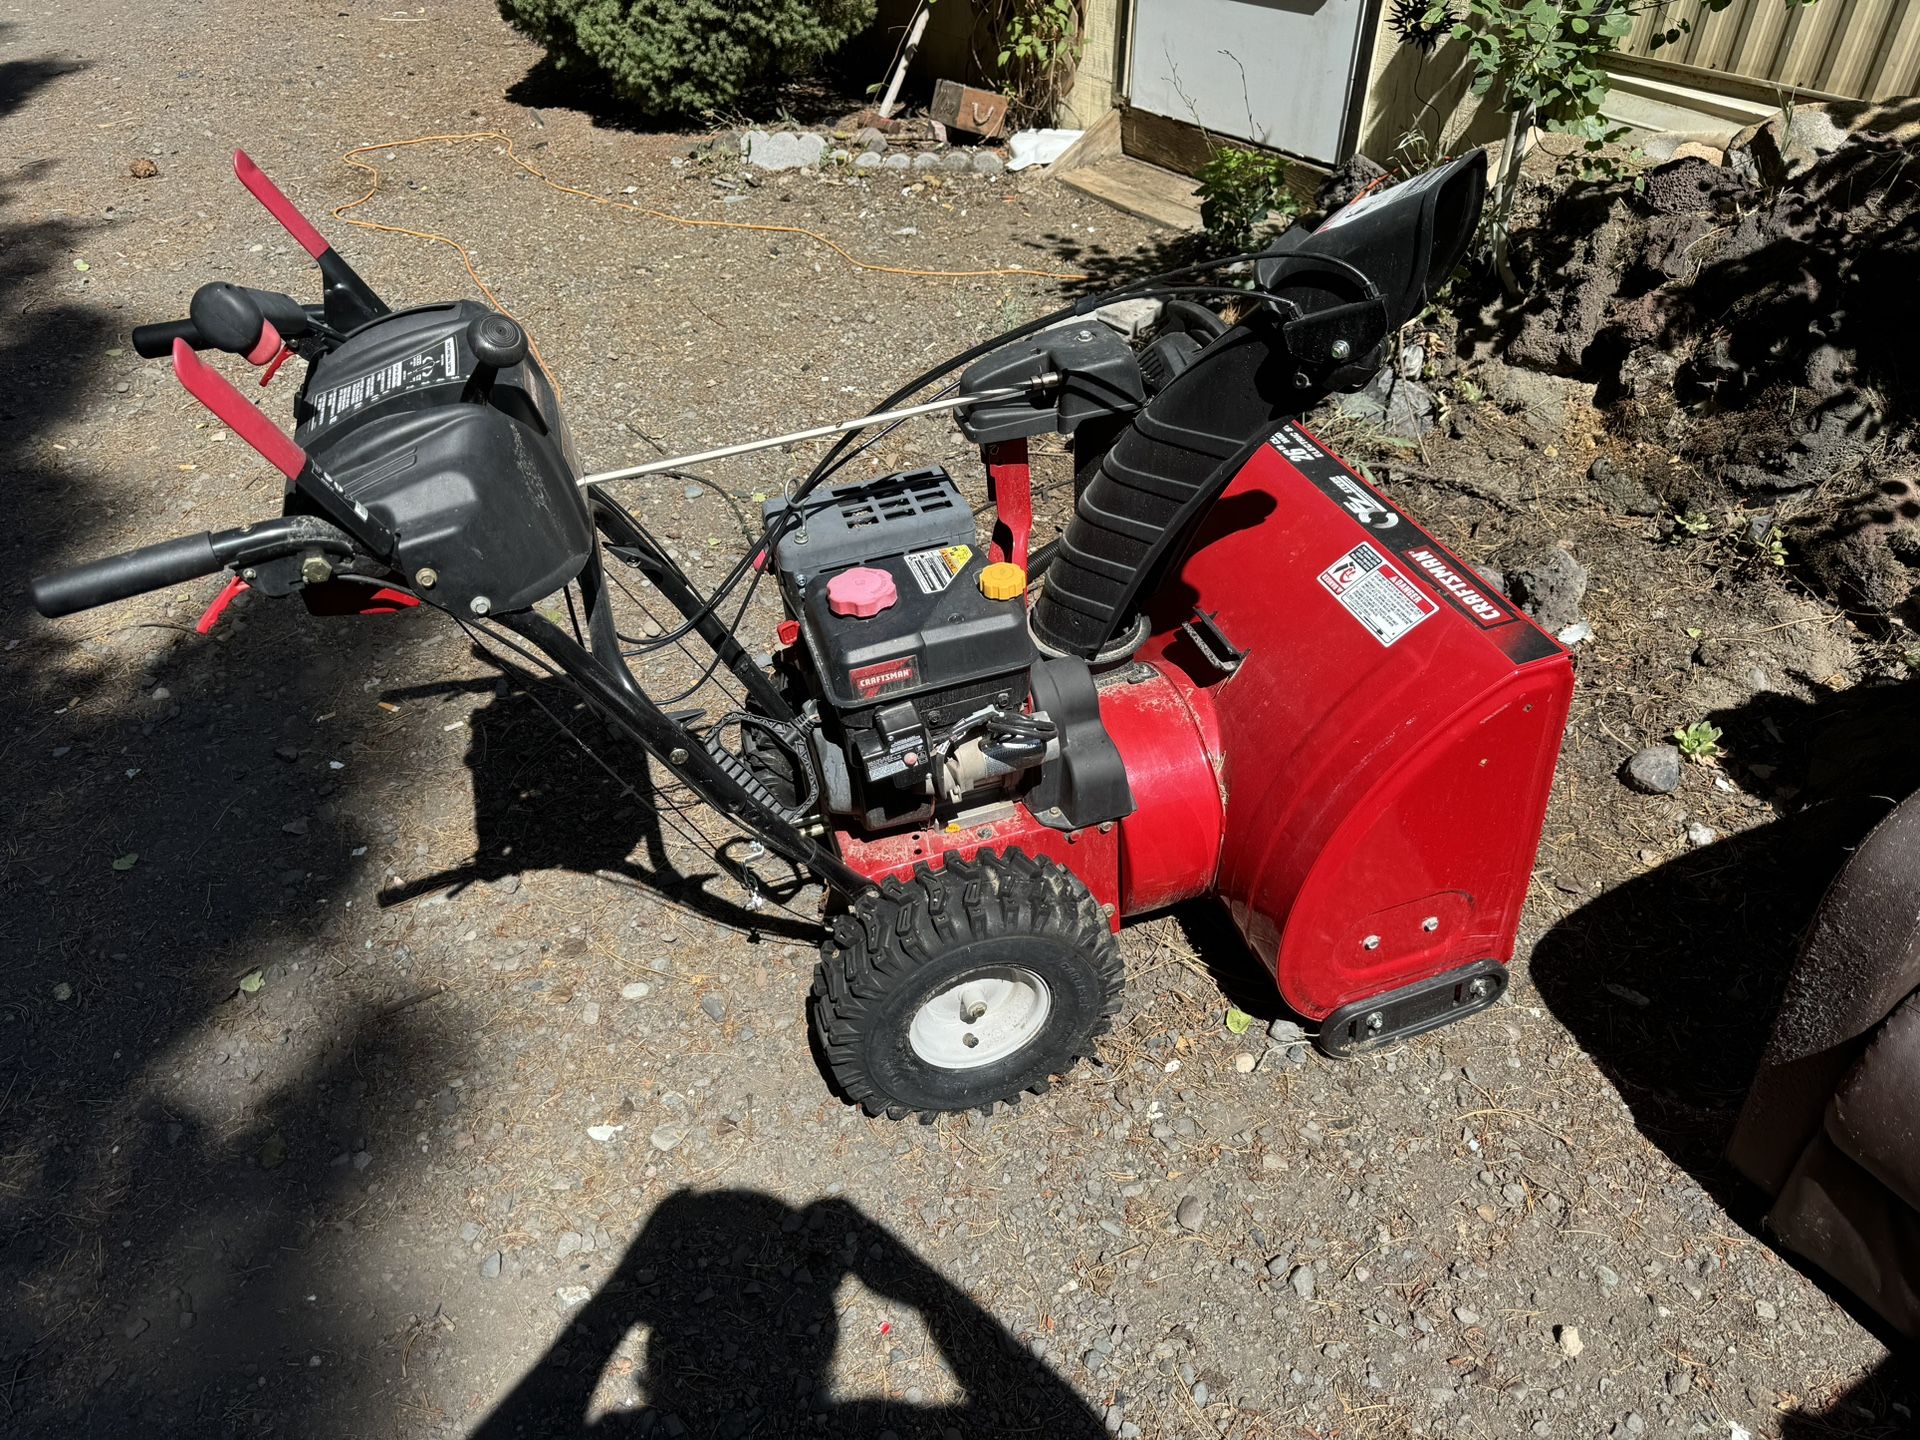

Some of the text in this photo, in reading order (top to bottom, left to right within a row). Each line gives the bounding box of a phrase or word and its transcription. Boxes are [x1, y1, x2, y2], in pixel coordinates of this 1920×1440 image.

[1290, 432, 1324, 457] ELECTRIC
[1394, 577, 1423, 604] DANGER
[1410, 550, 1501, 620] CRAFTSMAN
[860, 669, 909, 687] CRAFTSMAN
